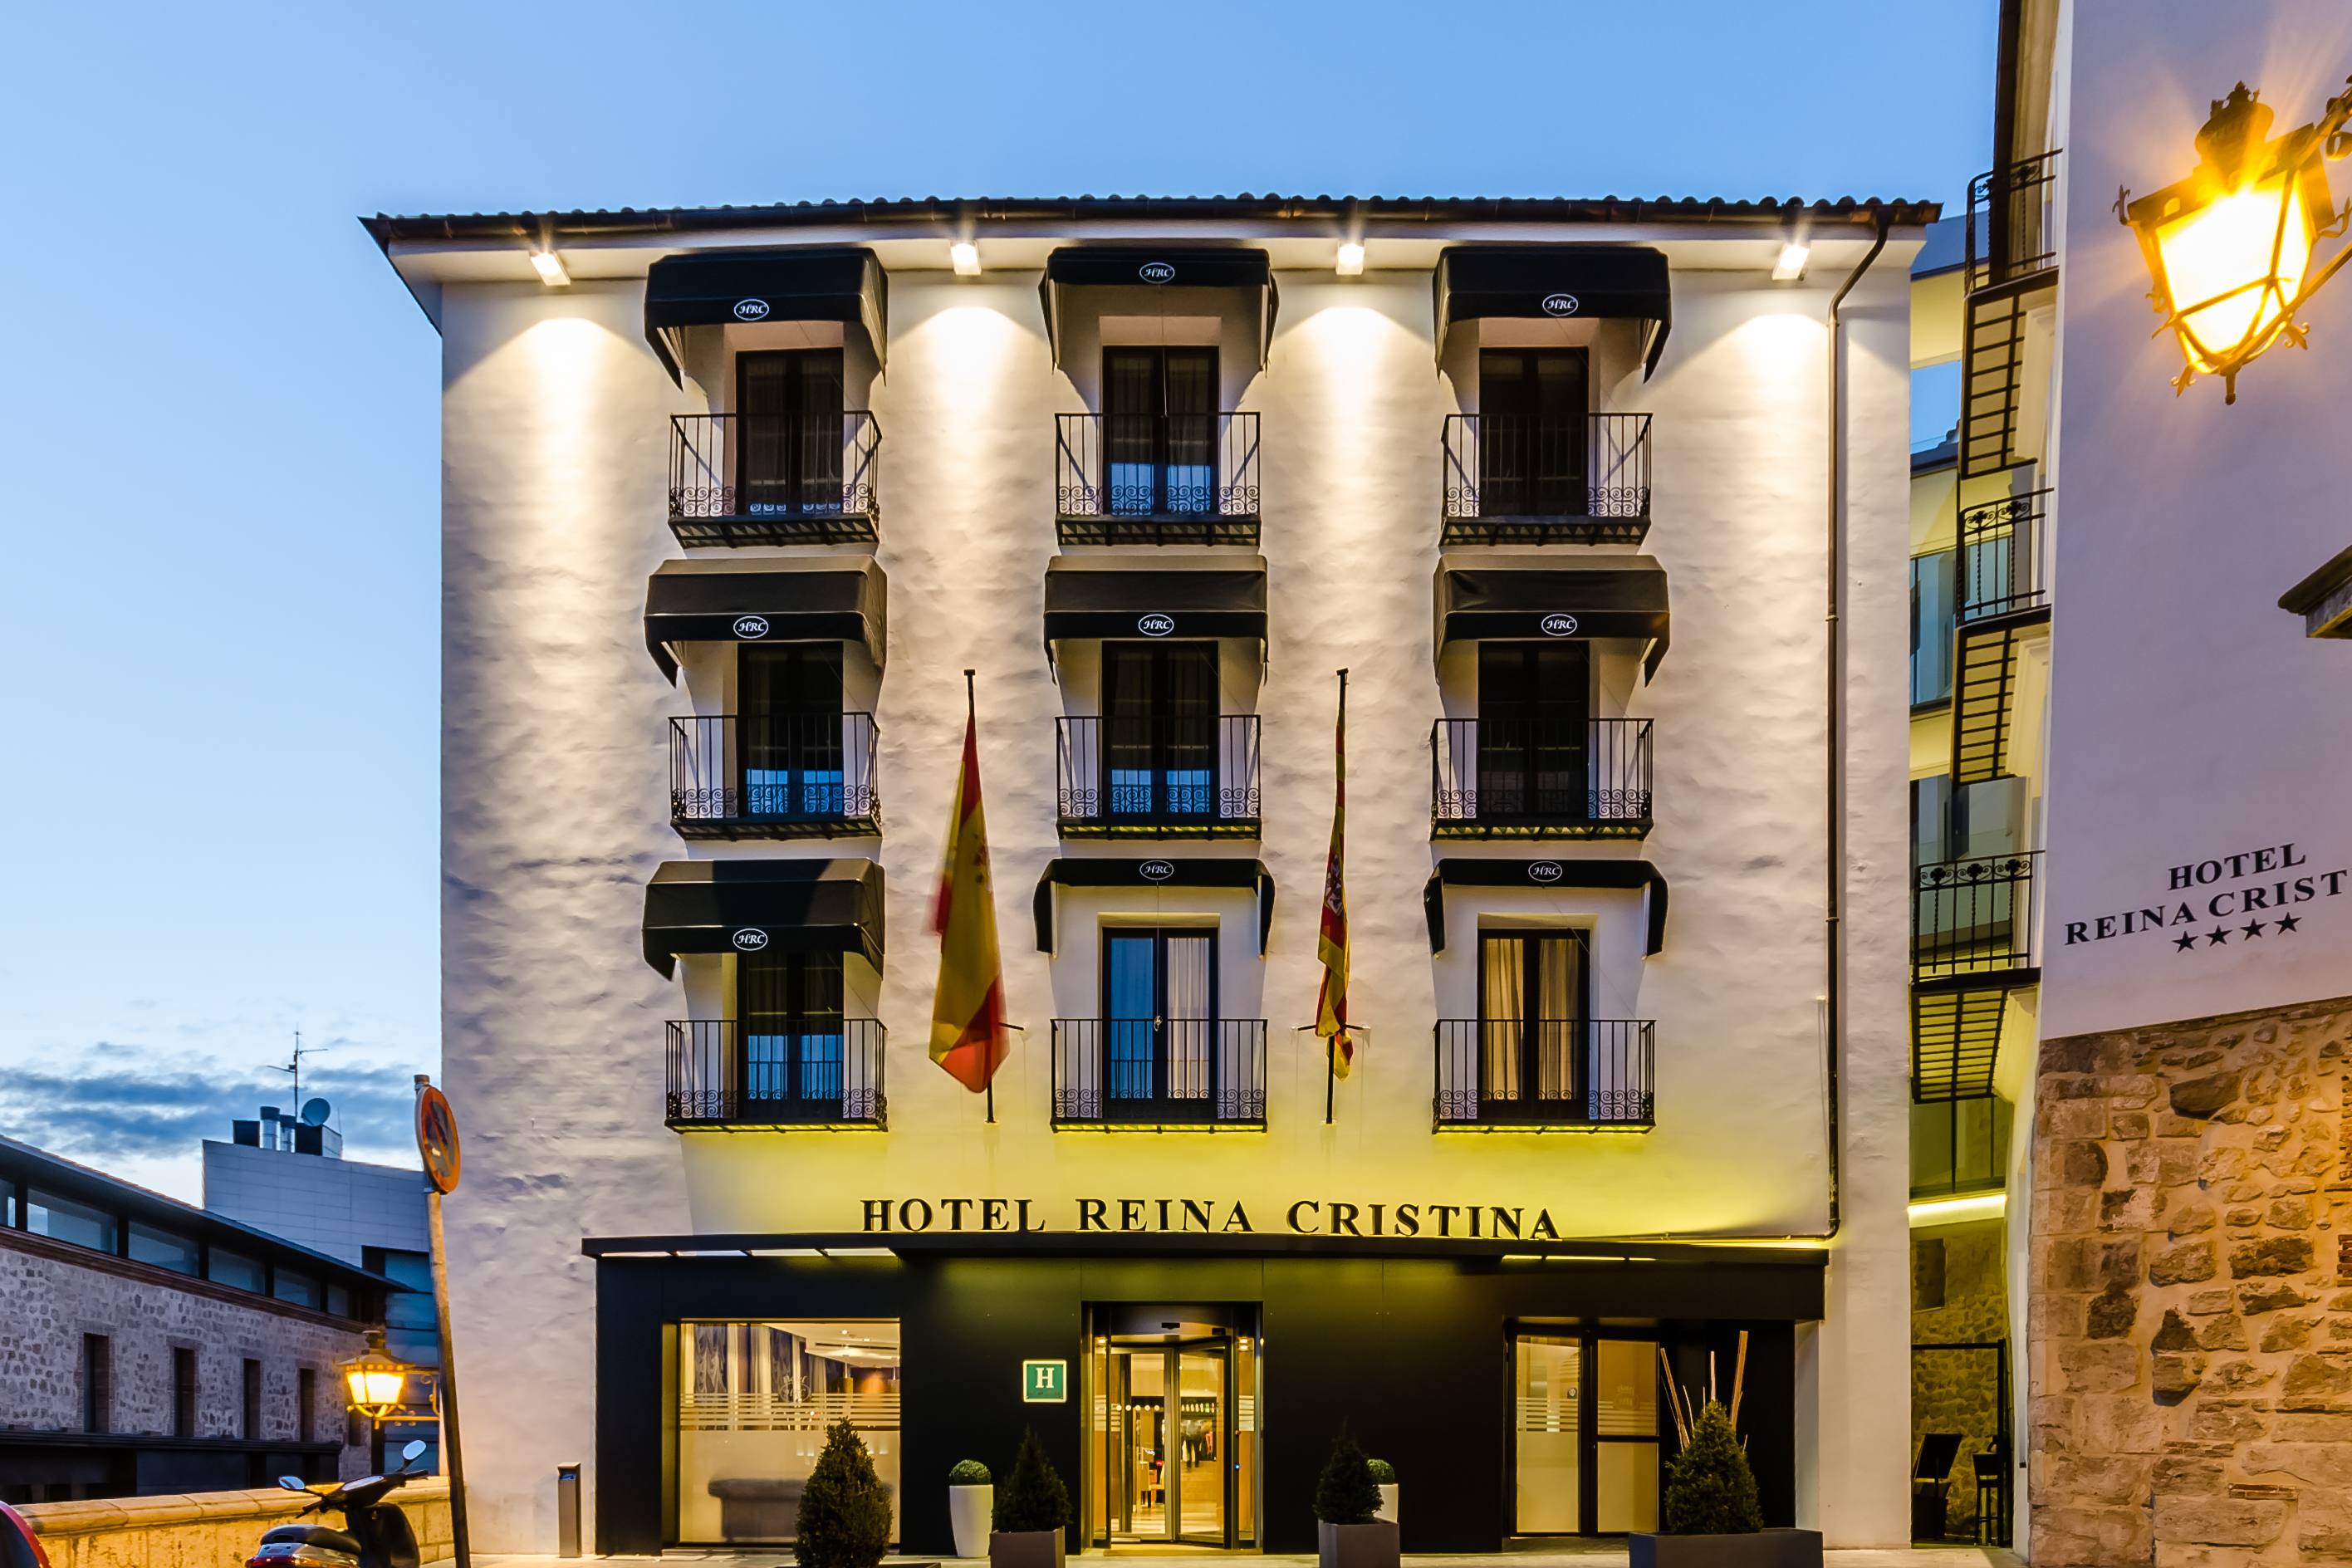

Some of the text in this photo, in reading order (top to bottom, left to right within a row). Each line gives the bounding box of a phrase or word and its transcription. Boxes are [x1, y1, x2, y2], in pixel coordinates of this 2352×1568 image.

[1144, 267, 1170, 277] HRC
[738, 303, 765, 315] HRC
[1546, 298, 1574, 310] HRC
[737, 620, 765, 632] HRC
[1143, 619, 1171, 630] HRC
[1546, 619, 1574, 630] HRC
[1144, 865, 1169, 874] HRC
[1532, 865, 1559, 875] HRC
[2168, 843, 2306, 891] HOTEL
[2064, 868, 2352, 946] REINA CRIST
[737, 933, 764, 944] HRC
[860, 1198, 1563, 1240] HOTEL REINA CRISTINA
[1035, 1367, 1055, 1389] H
